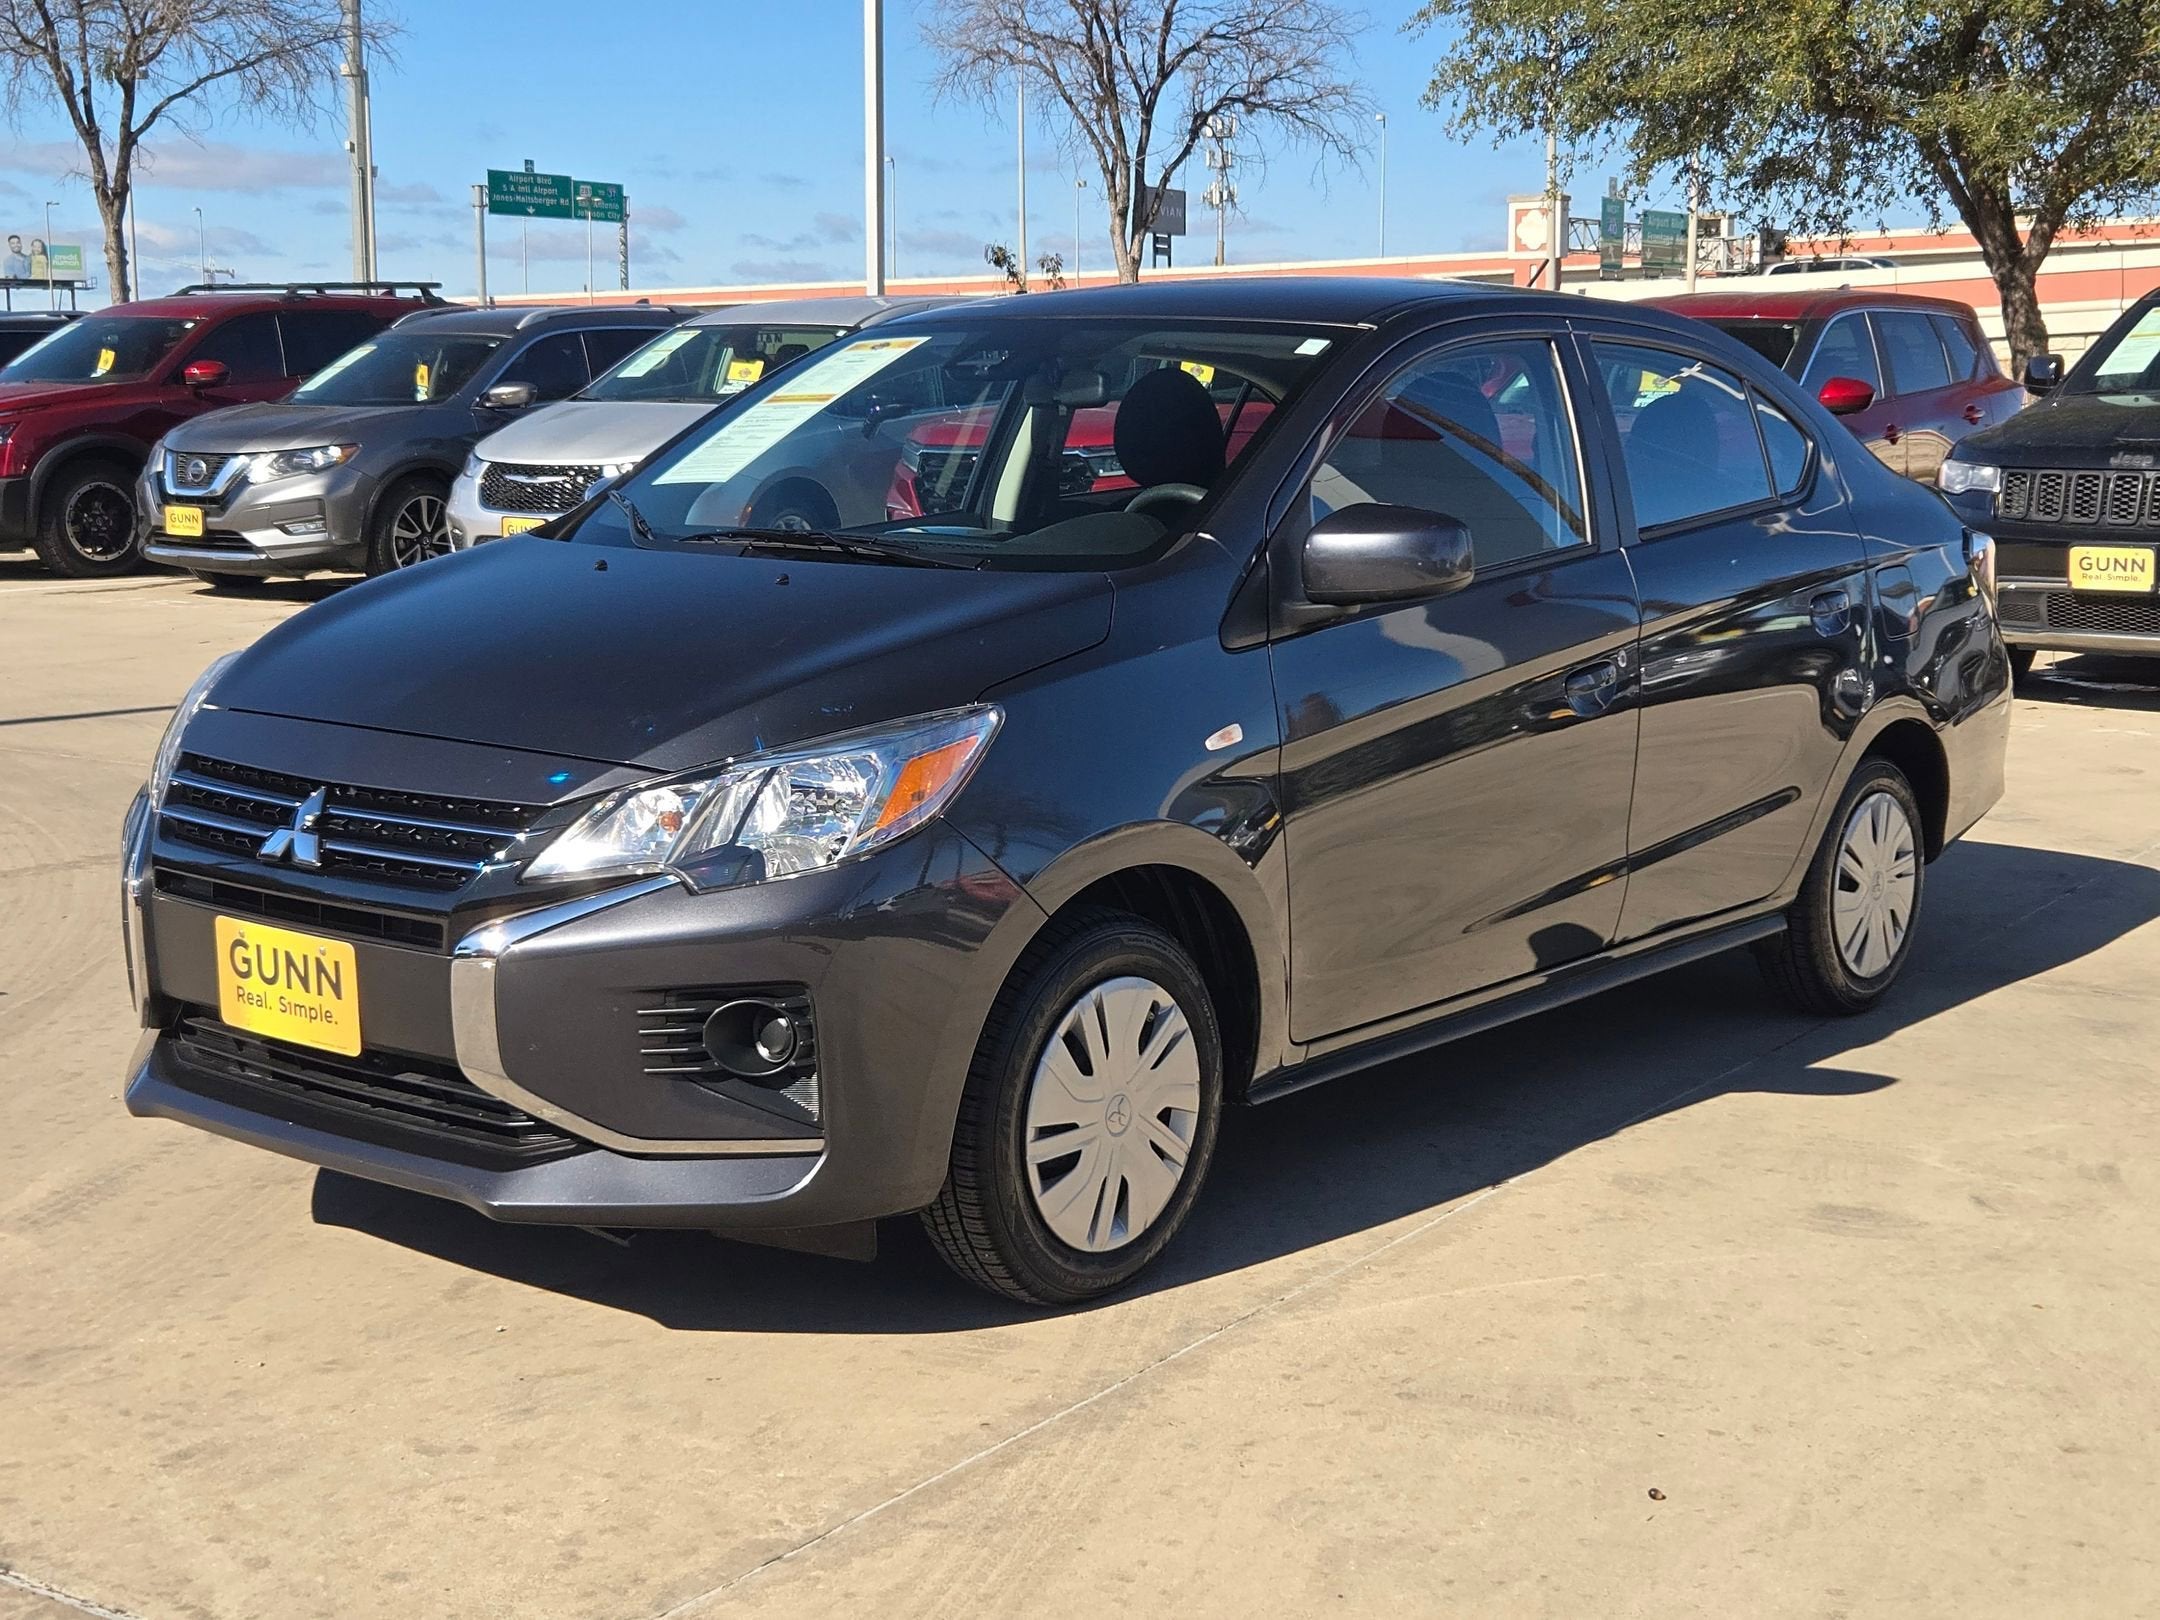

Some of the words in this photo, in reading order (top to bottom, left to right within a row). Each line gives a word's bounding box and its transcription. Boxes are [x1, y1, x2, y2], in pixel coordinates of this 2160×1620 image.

[508, 174, 534, 184] Airport
[536, 176, 552, 186] Blvd
[502, 184, 508, 192] S
[510, 184, 516, 192] A
[533, 186, 558, 196] Airport
[560, 198, 570, 206] Rd
[607, 211, 621, 221] City
[2109, 451, 2154, 467] Jeep
[170, 512, 199, 525] GUNN
[507, 524, 532, 536] GUN
[2079, 555, 2146, 573] GUNN
[2107, 573, 2142, 583] Simple.
[229, 937, 343, 1001] GUNN
[236, 985, 273, 1011] Real.
[278, 996, 339, 1026] Simple.
